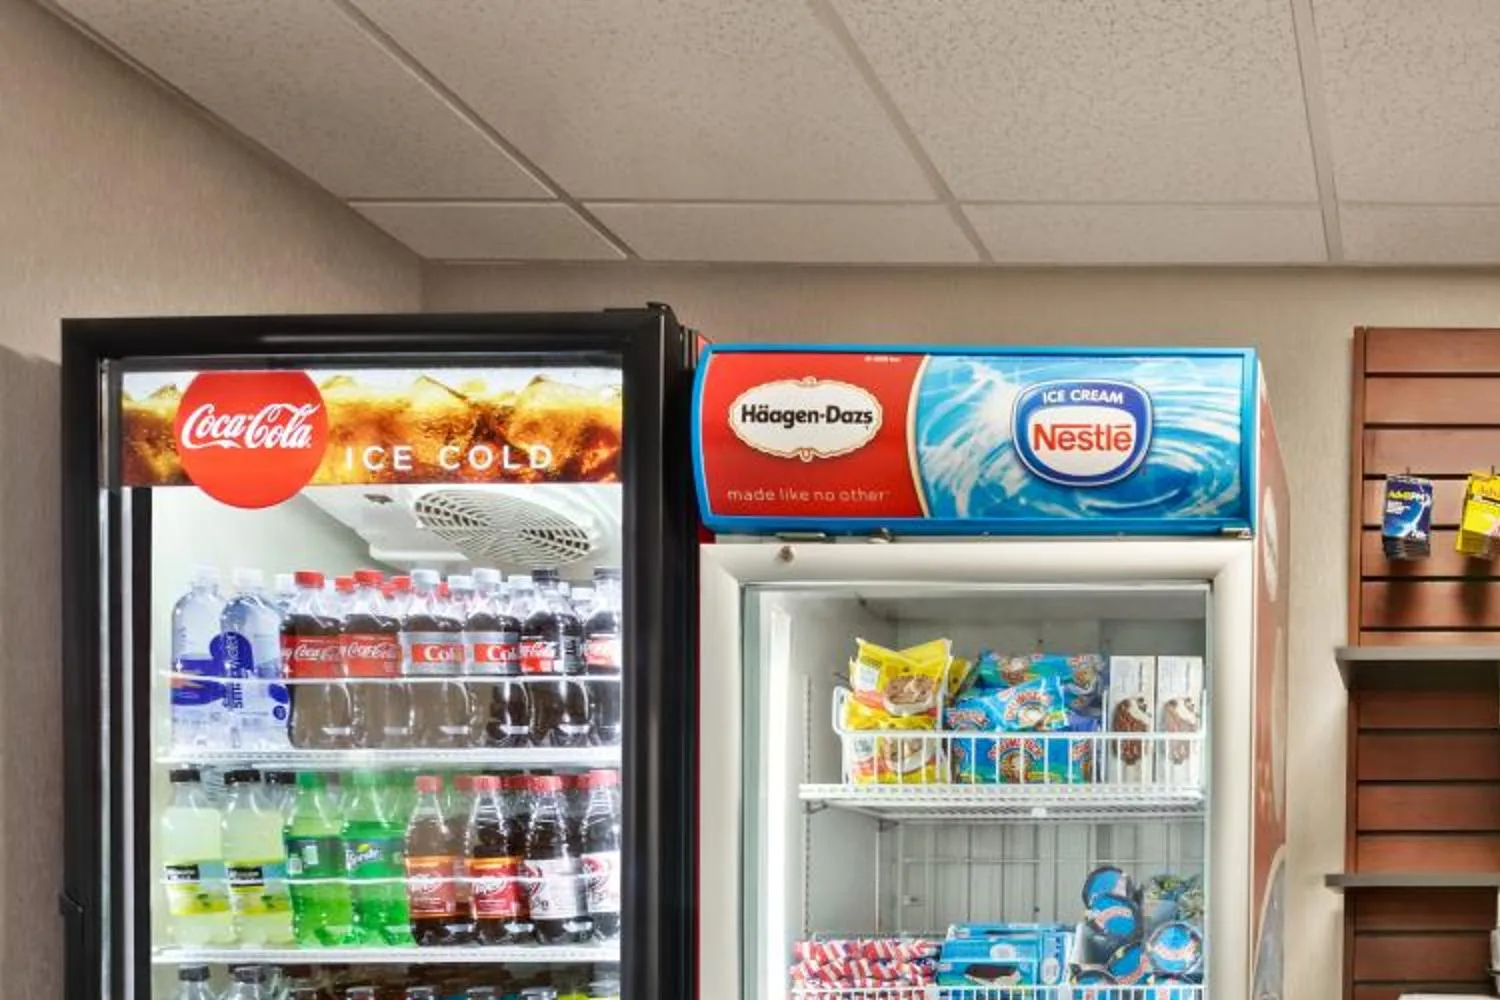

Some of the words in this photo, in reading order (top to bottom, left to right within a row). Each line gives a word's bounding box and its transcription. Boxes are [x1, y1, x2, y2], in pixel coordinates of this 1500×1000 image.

[1043, 389, 1065, 404] ICE
[1070, 388, 1125, 405] CREAM
[180, 402, 321, 449] Coca-Cola
[740, 403, 874, 429] Häagen-Dazs
[344, 445, 413, 471] ICE
[438, 444, 554, 471] COLD
[727, 487, 775, 502] made
[779, 487, 810, 502] like
[813, 490, 836, 502] no
[839, 487, 886, 502] other
